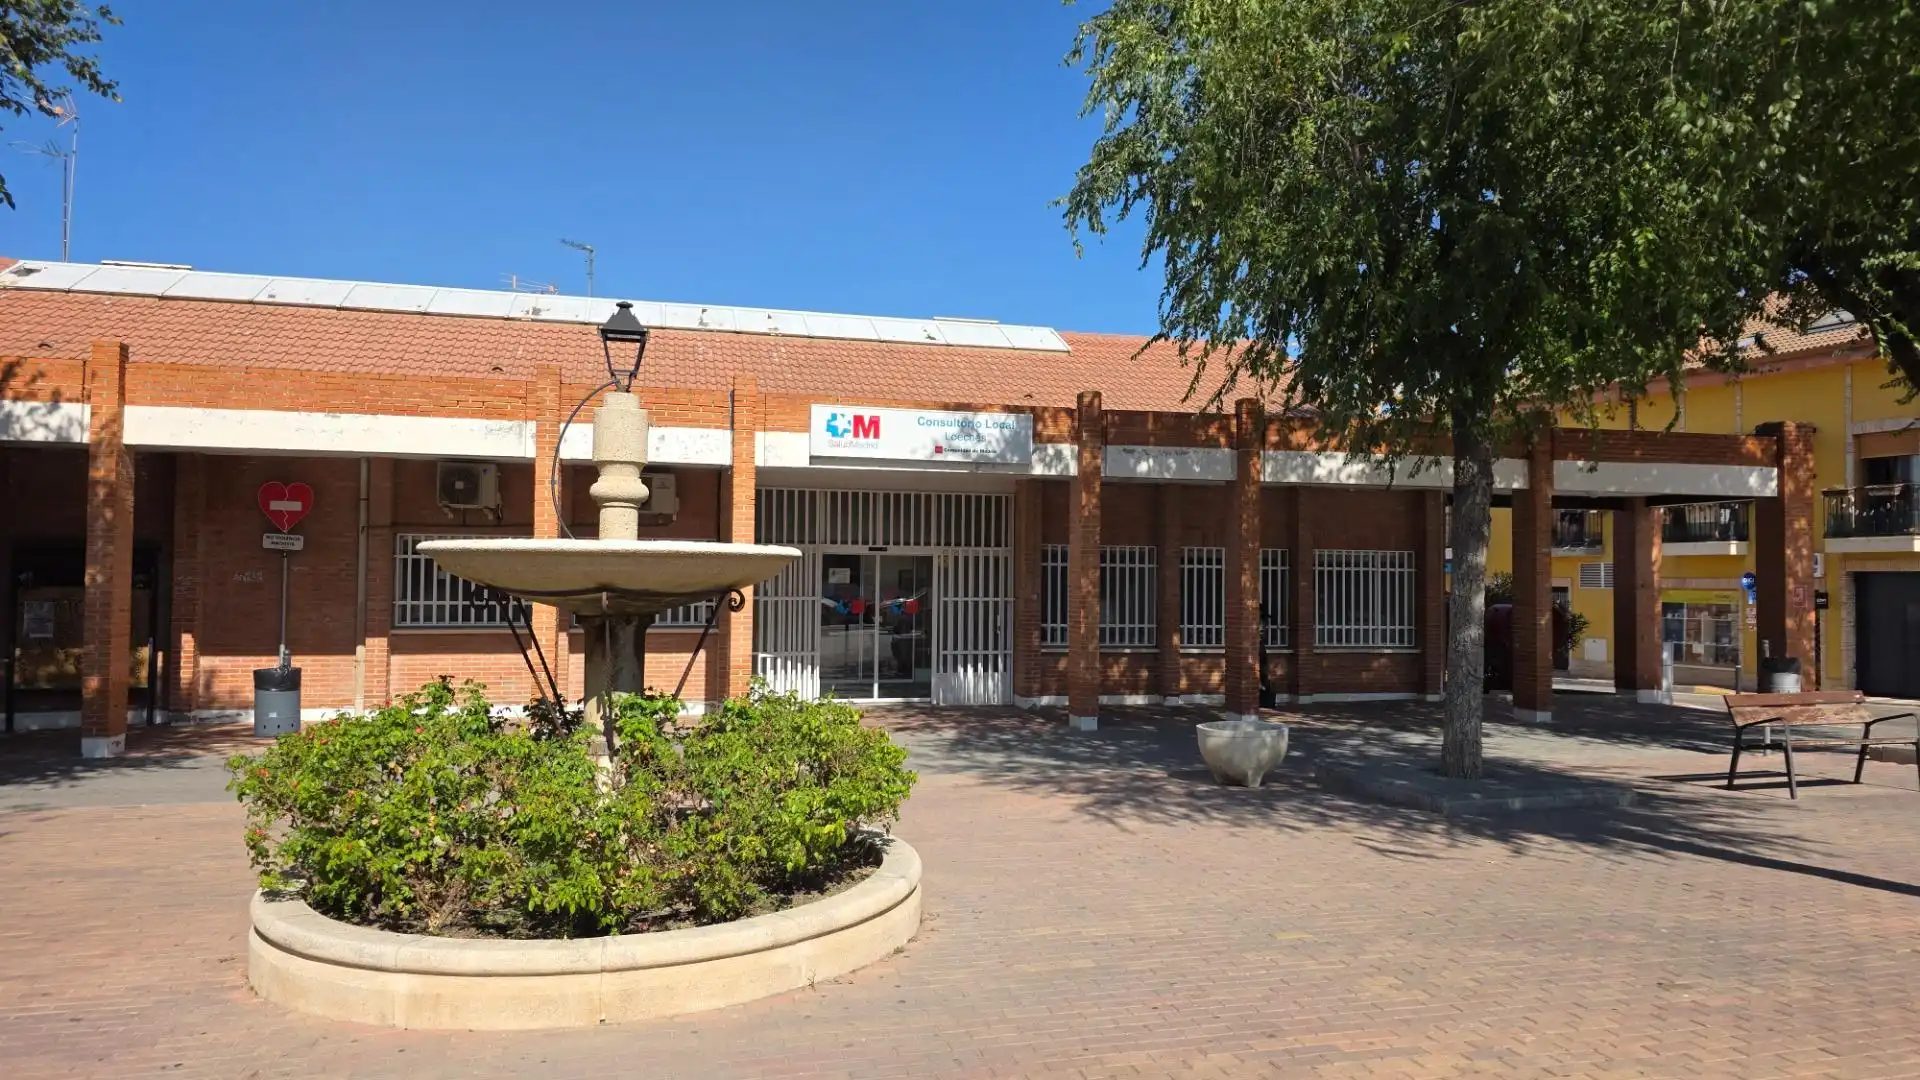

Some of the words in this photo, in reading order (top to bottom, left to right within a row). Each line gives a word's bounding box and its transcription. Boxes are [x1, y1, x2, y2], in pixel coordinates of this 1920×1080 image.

[917, 416, 982, 429] Consultorio
[985, 419, 1016, 430] Local
[945, 431, 987, 443] Loeches
